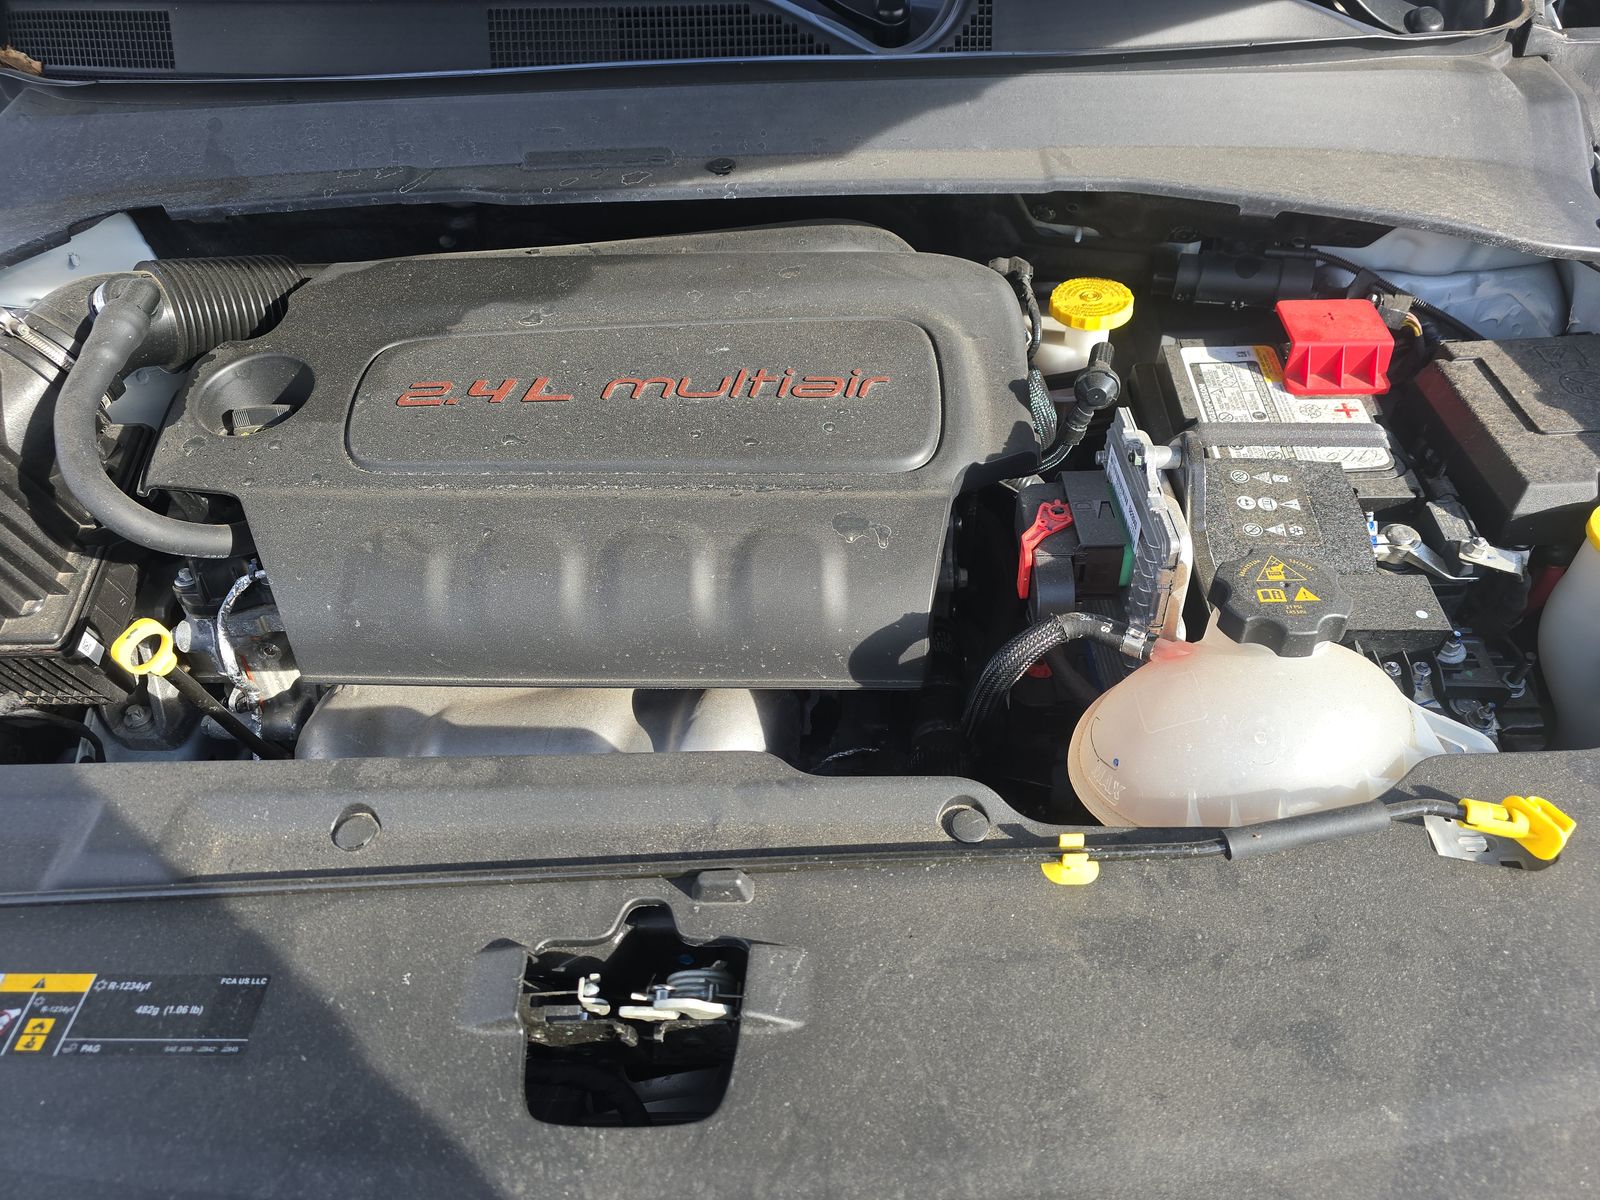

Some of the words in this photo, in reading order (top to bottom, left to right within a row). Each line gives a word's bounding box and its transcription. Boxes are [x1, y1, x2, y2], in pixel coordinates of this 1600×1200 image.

[600, 367, 892, 400] multiair
[107, 981, 152, 992] R-1234yf
[221, 977, 237, 985] FCA
[238, 977, 250, 985] US
[251, 977, 268, 985] LLC
[135, 1005, 160, 1016] 482g
[163, 1004, 188, 1016] (1.06
[190, 1004, 204, 1016] lb)
[80, 1044, 101, 1053] PAG
